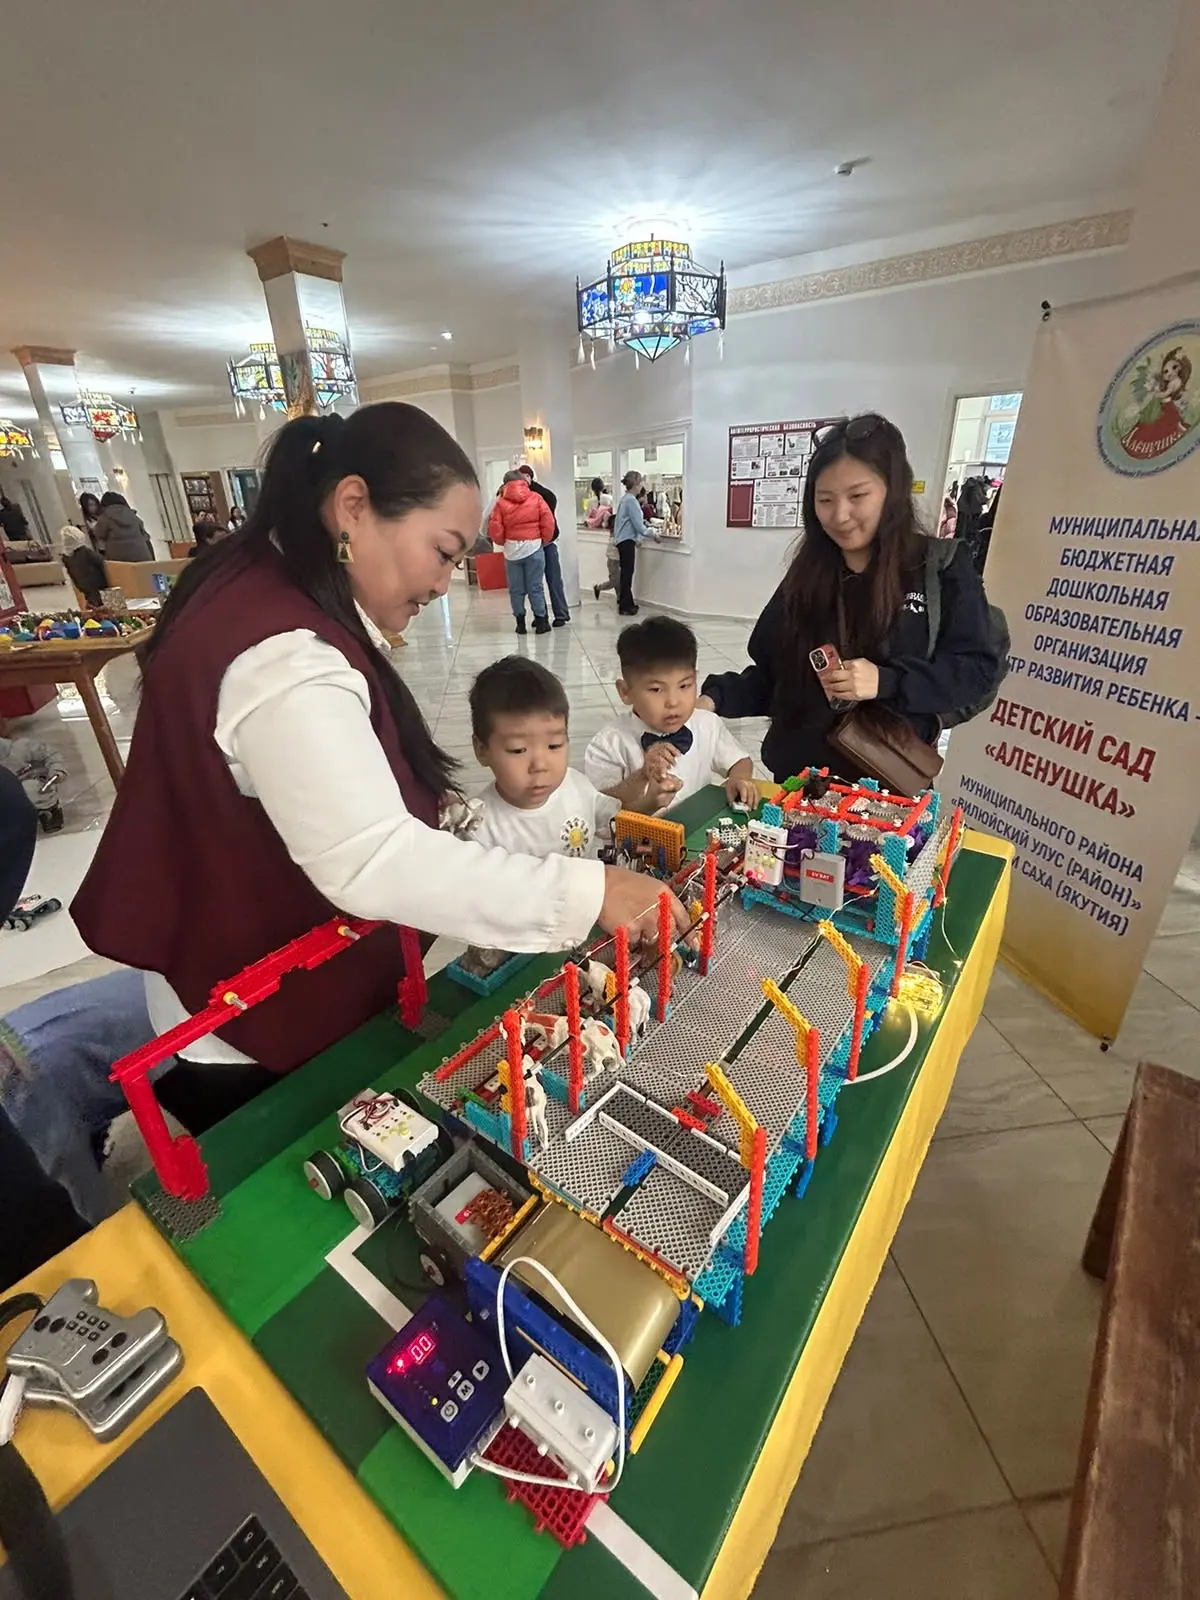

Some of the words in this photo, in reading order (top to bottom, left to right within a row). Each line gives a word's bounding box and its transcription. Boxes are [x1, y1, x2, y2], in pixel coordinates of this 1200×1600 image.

[1049, 516, 1200, 542] МУНИЦИПАЛЬНА
[1060, 548, 1175, 576] БЮДЖЕТНАЯ
[1046, 577, 1169, 611] ДОШКОЛЬНАЯ
[1025, 603, 1183, 649] ОБРАЗОВАТЕЛЬНАЯ
[1034, 634, 1148, 676] ОРГАНИЗАЦИЯ
[1027, 661, 1104, 697] РАЗВИТИЯ
[1106, 682, 1190, 722] РЕБЕНКА
[990, 698, 1094, 755] ДЕТСКИЙ
[1097, 735, 1156, 783] САД
[985, 741, 1135, 818] «АЛЕНУШКА»
[960, 775, 1076, 846] МУНИЦИПАЛЬНОГО
[1078, 836, 1144, 882] РАЙОНА
[1021, 859, 1053, 890] САХА
[1056, 880, 1129, 936] (ЯКУТИЯ)
[1032, 837, 1065, 868] УЛУС
[1066, 856, 1141, 910] (РАЙОН)»
